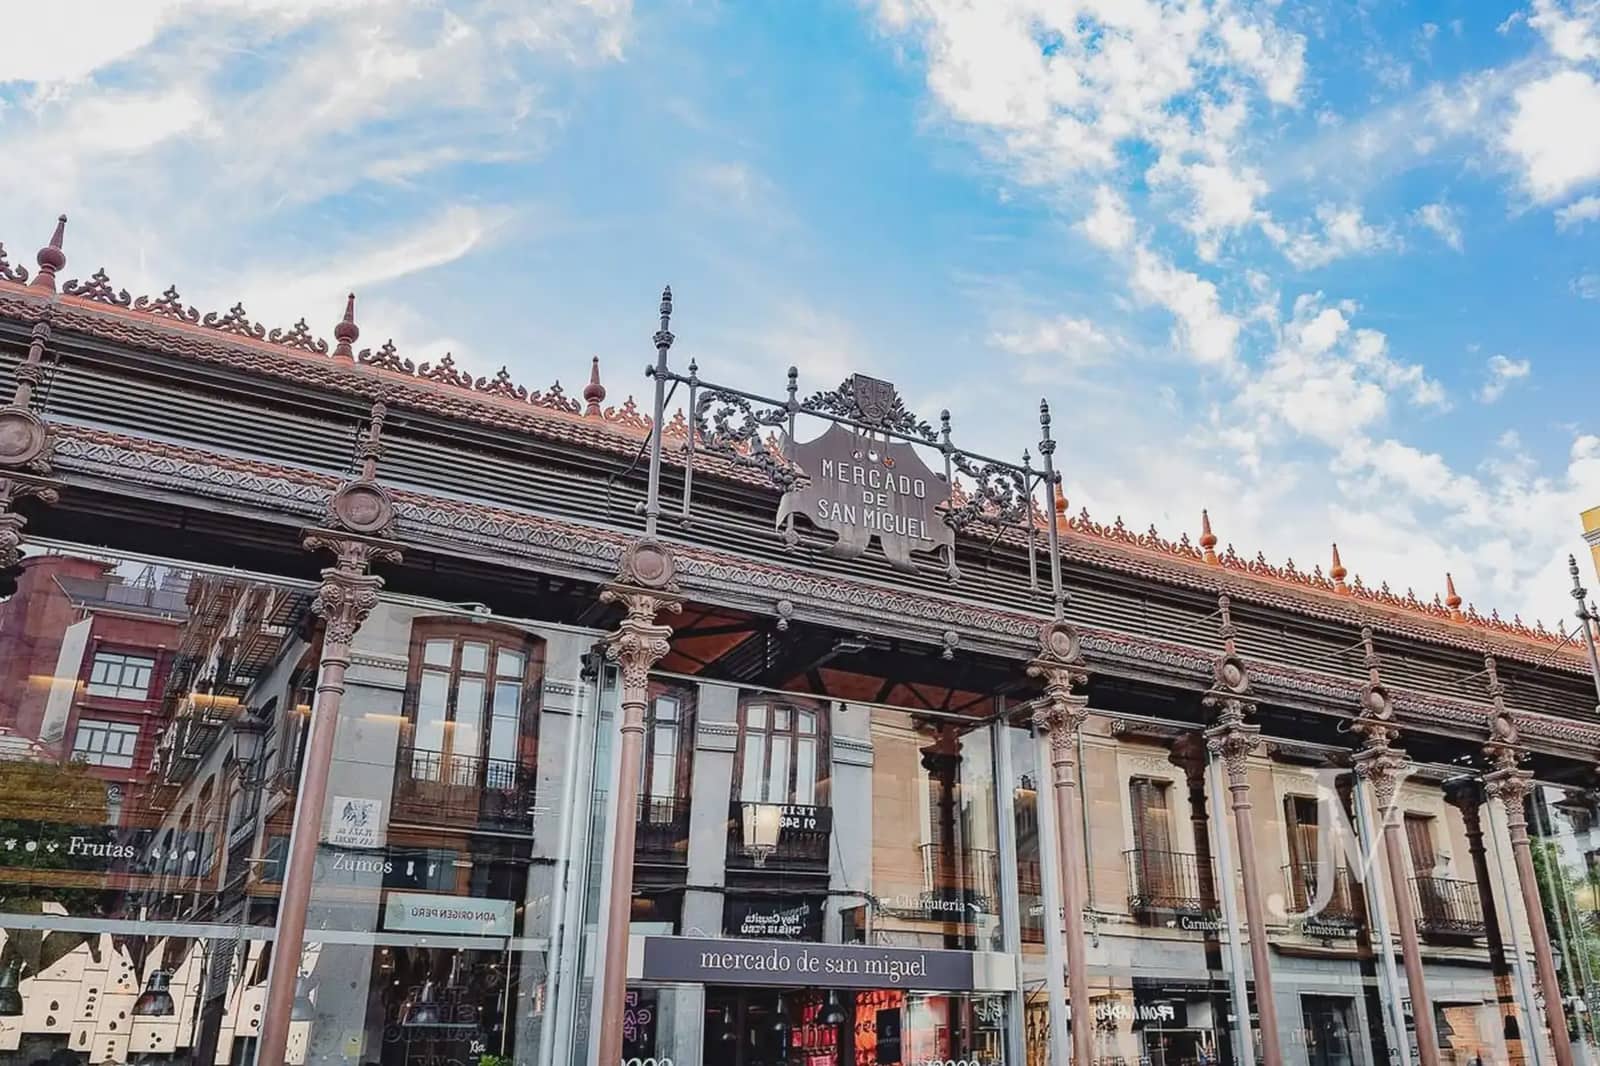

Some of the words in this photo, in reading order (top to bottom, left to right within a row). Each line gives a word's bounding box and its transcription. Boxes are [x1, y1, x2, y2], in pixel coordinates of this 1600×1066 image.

[822, 458, 926, 499] MERCADO
[863, 491, 889, 507] DE
[818, 499, 856, 525] SAN
[67, 836, 134, 858] Frutas
[333, 853, 392, 873] Zumos
[701, 949, 790, 971] mercado
[797, 950, 820, 973] de
[825, 957, 858, 974] san
[864, 955, 928, 983] miguel
